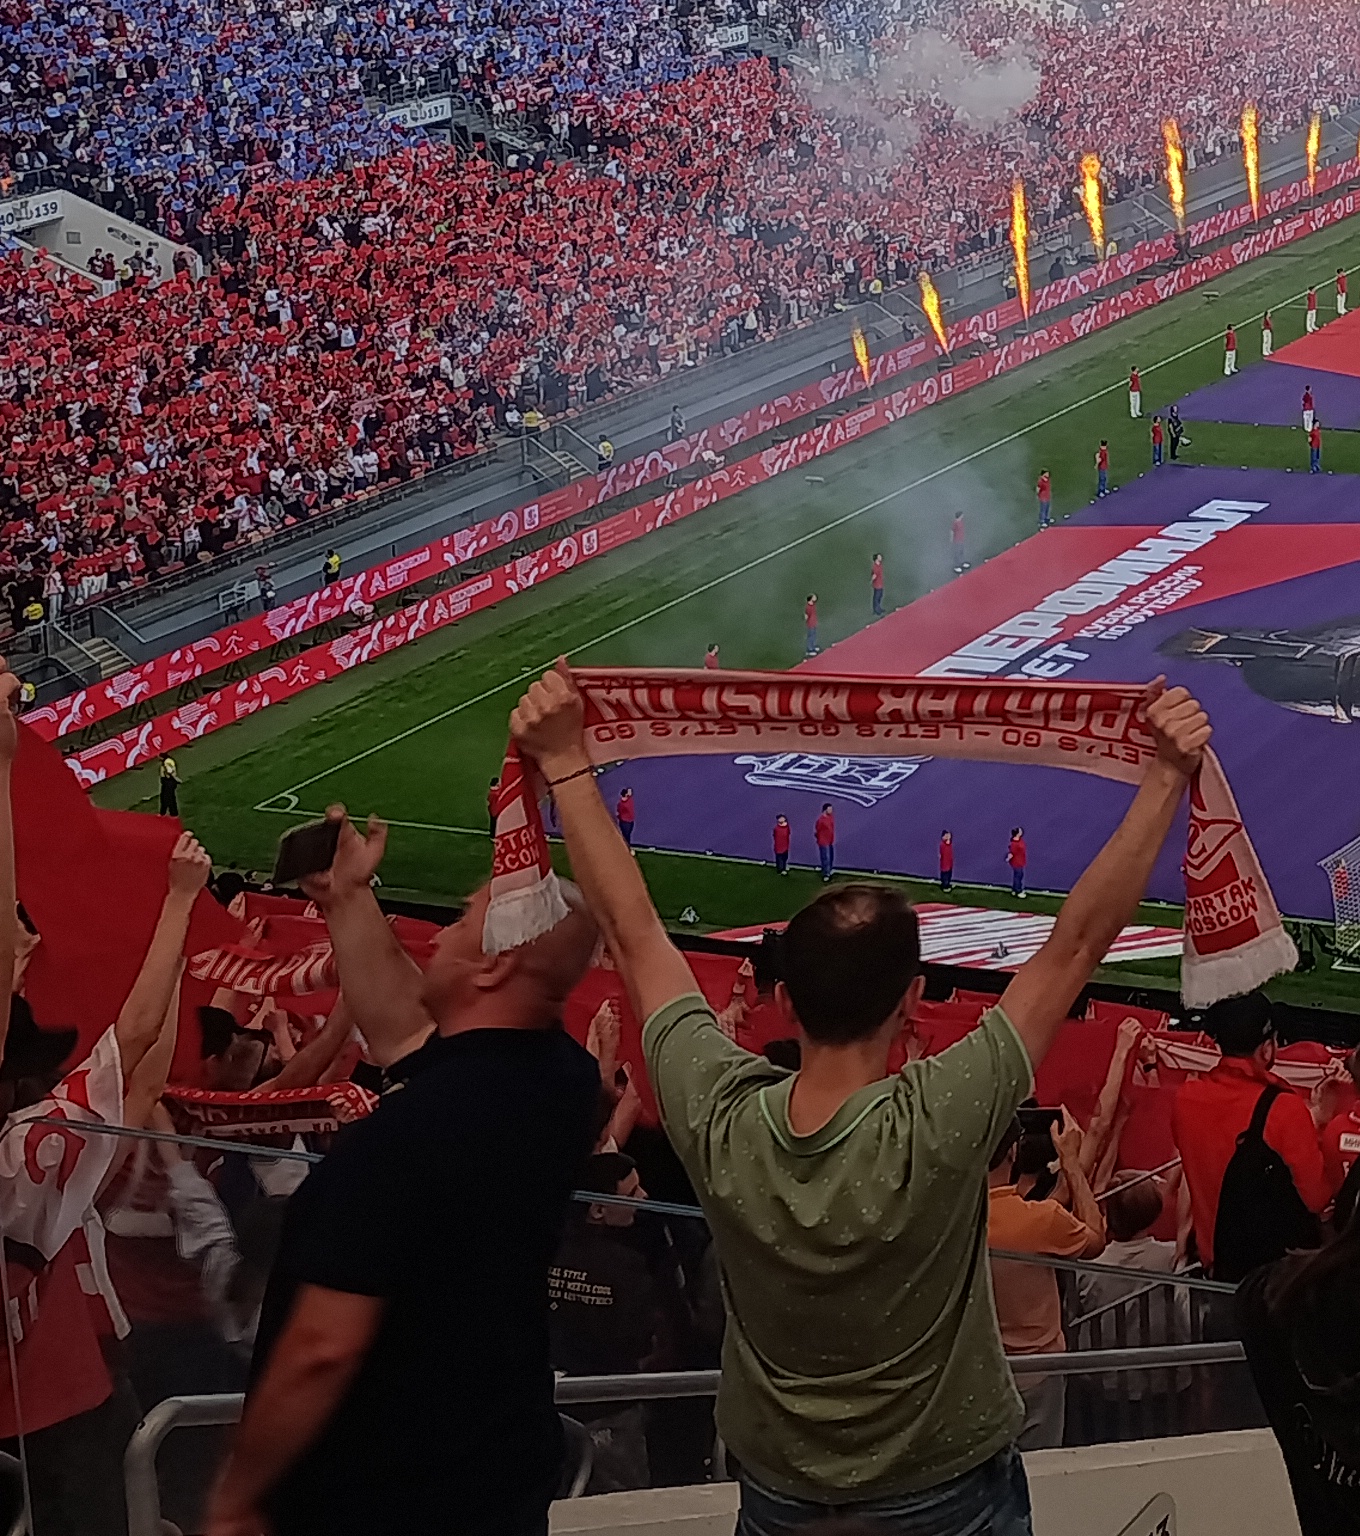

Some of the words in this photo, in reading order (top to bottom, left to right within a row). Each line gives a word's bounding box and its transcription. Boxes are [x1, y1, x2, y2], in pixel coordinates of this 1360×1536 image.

[35, 201, 58, 219] 139
[914, 498, 1271, 679] ПЕРФИНАЛ
[1073, 602, 1140, 639] КУБОК
[1127, 565, 1204, 605] РОССИИ
[1097, 624, 1133, 641] ПО
[1122, 578, 1203, 625] ФУТБОЛУ
[586, 683, 851, 722] MOSCOW
[1187, 876, 1257, 917] PARTAK
